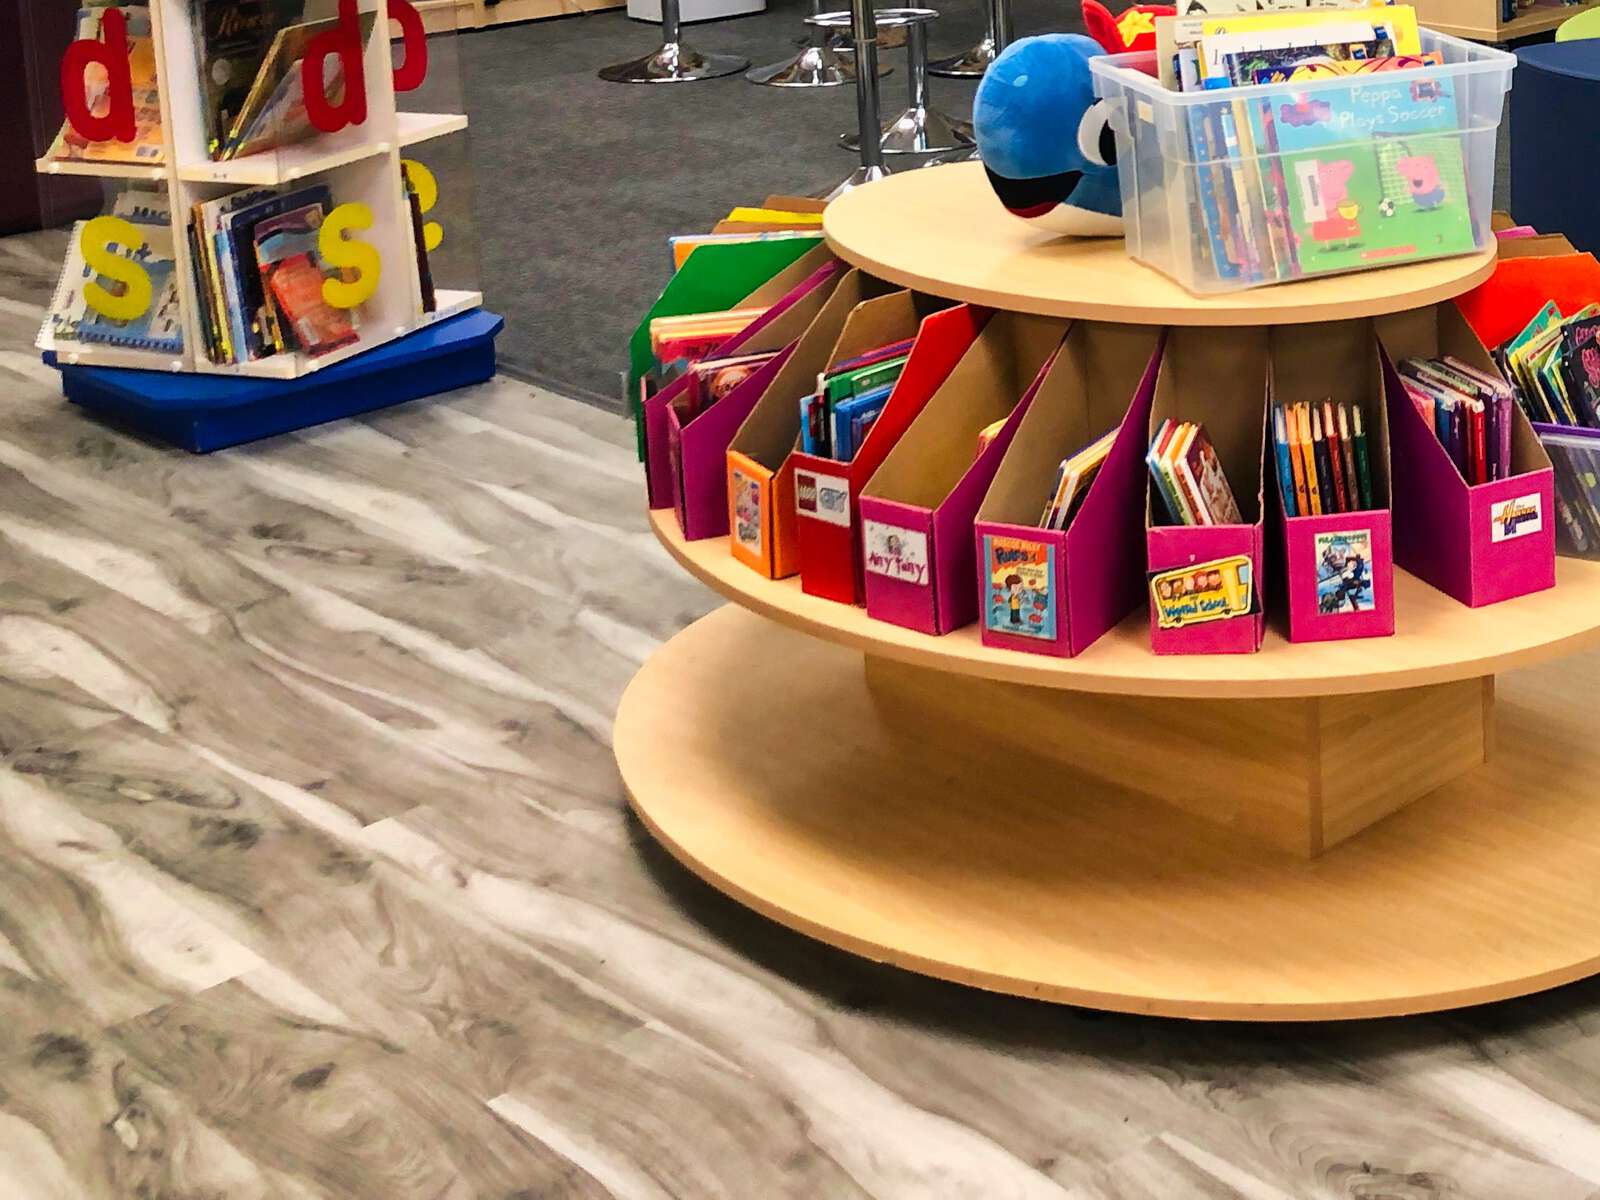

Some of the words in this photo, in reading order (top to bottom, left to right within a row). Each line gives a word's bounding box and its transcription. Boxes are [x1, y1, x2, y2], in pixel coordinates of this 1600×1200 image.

[1350, 87, 1402, 106] Peppa
[1339, 111, 1384, 131] Plays
[1388, 105, 1446, 123] Soccer
